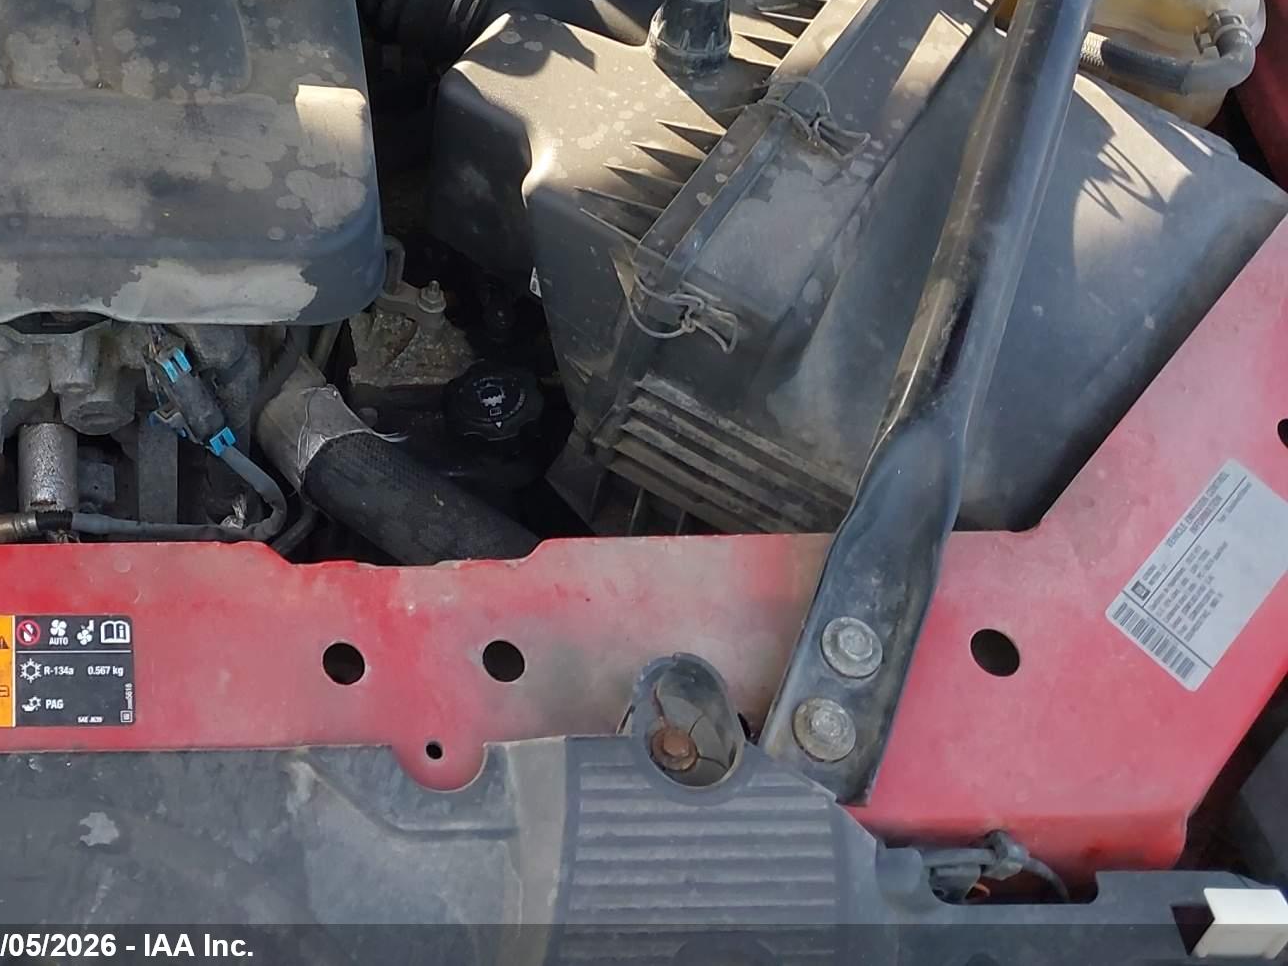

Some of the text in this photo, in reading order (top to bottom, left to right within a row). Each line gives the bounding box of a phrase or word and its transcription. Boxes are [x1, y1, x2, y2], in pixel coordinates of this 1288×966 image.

[49, 636, 69, 646] AUTO
[43, 666, 124, 677] R-134a 0.567 kg
[45, 699, 64, 710] PAG
